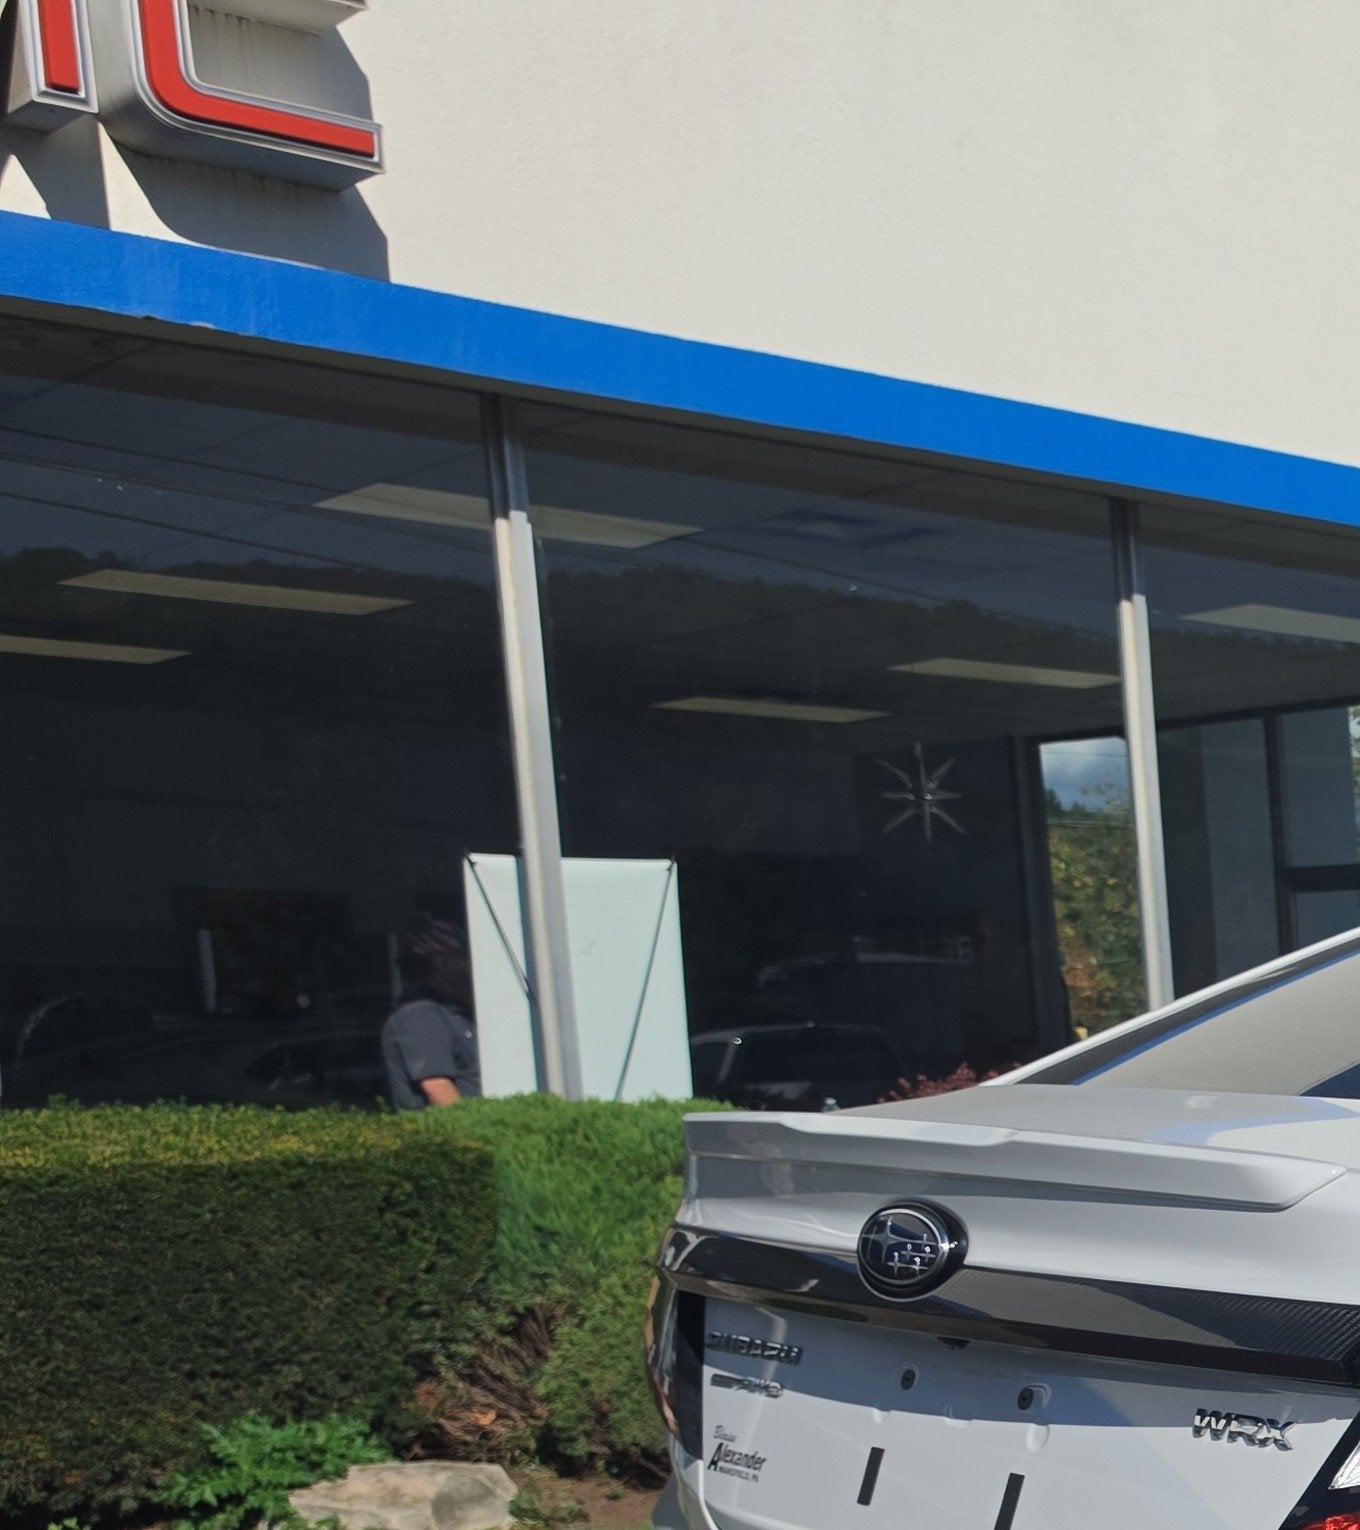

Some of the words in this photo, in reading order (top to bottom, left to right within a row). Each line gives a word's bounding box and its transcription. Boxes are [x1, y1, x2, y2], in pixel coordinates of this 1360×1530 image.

[706, 1331, 804, 1365] SUBARU
[1192, 1408, 1296, 1451] WRX
[707, 1442, 767, 1471] Alexander
